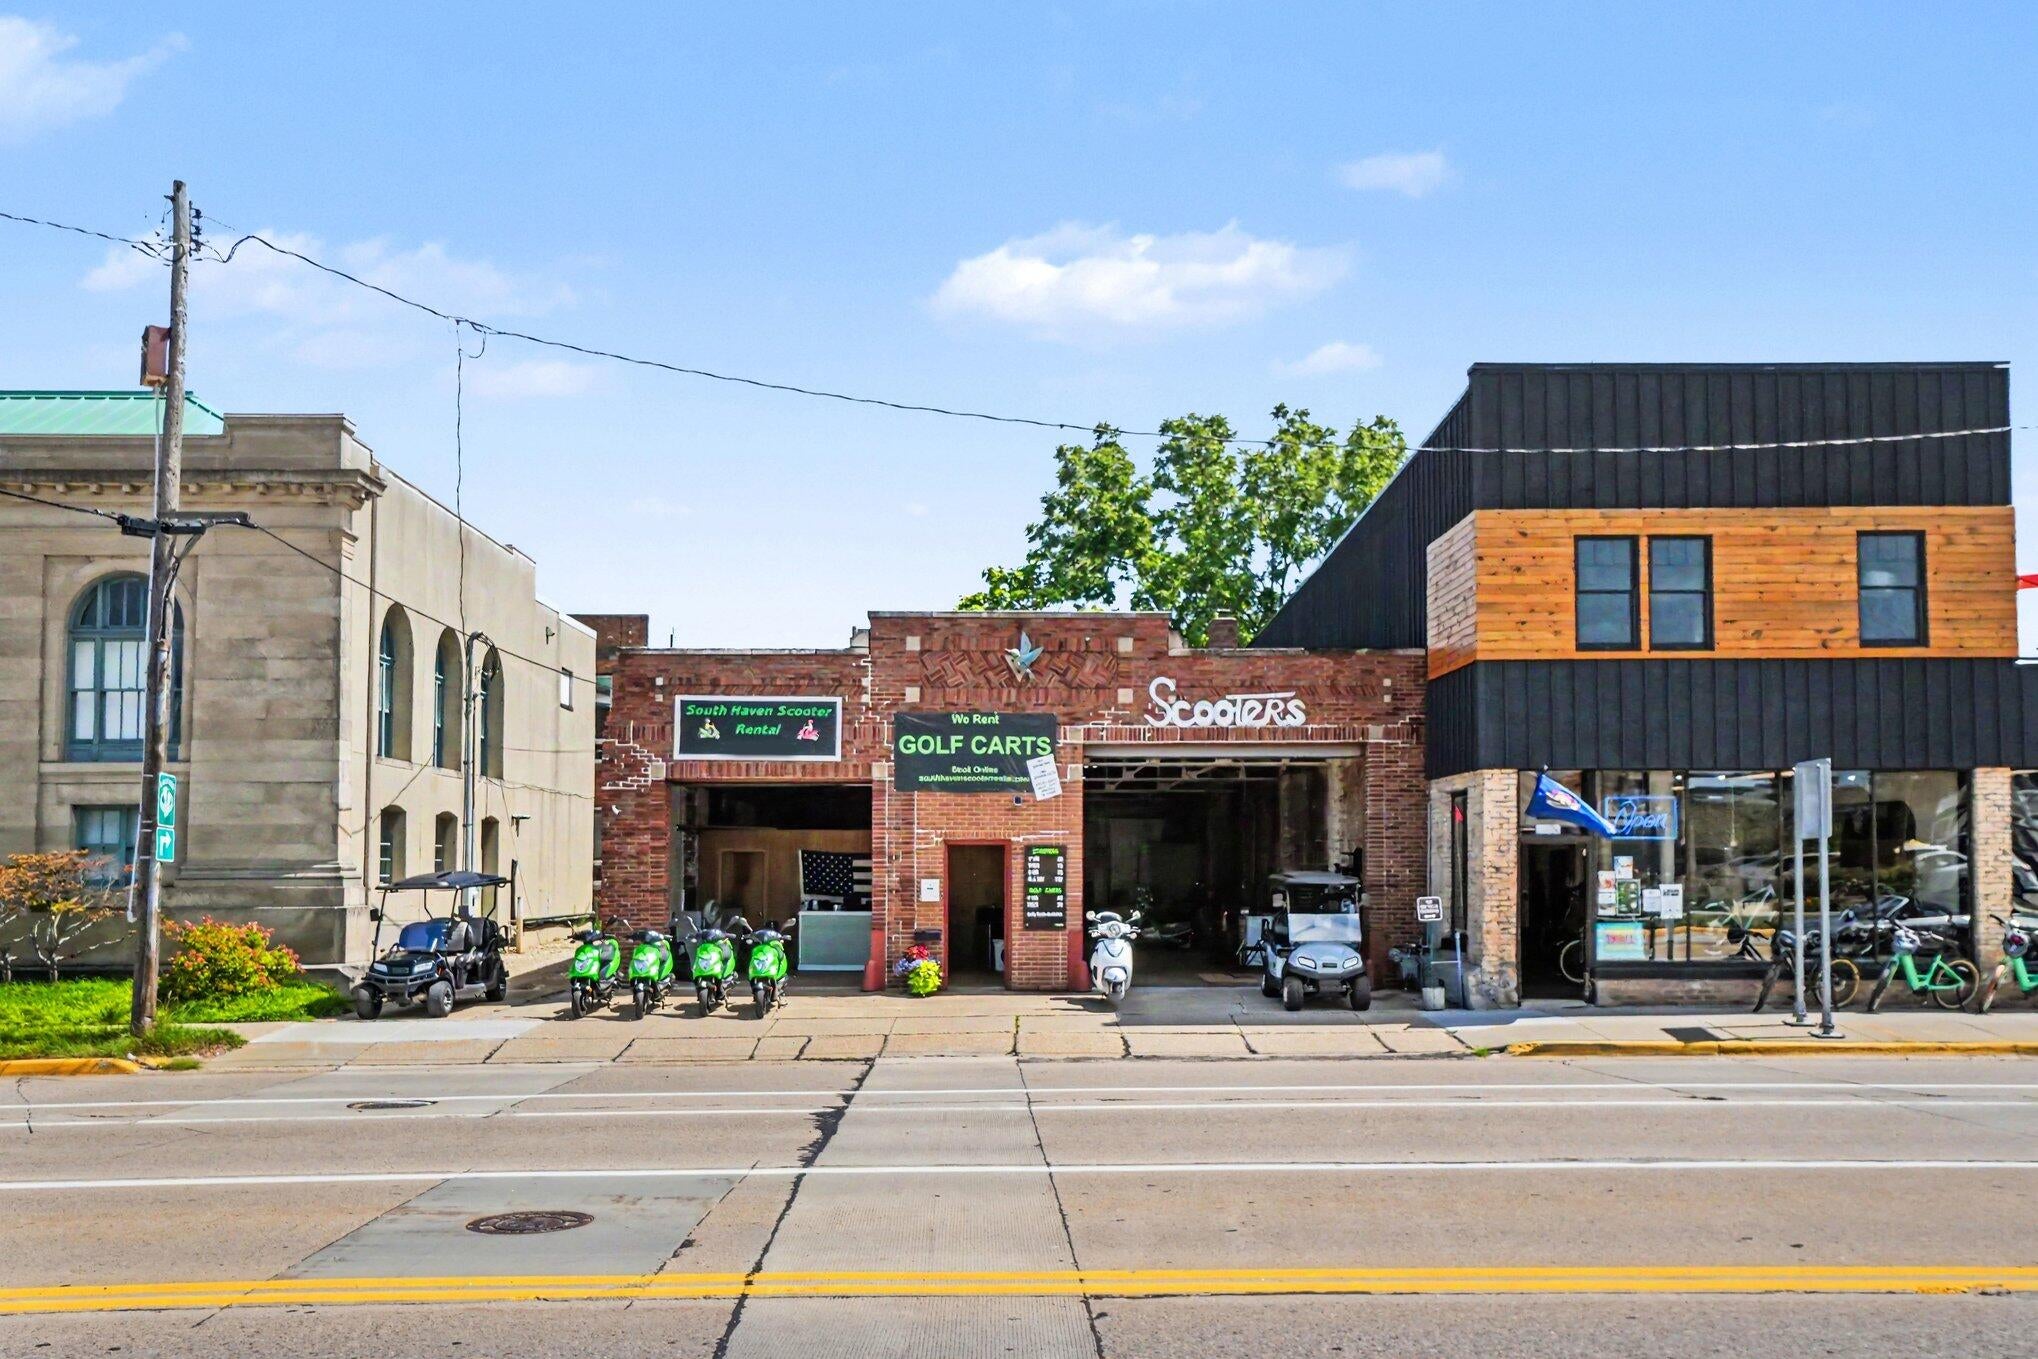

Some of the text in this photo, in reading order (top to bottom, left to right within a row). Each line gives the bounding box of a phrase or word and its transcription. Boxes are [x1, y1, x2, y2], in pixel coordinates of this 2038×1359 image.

[686, 704, 833, 718] South Haven Scooter
[951, 713, 1000, 725] We Rent
[735, 723, 782, 736] Rental
[898, 735, 1052, 756] GOLF CARTS
[951, 765, 998, 774] Book Online
[1614, 799, 1668, 835] Open
